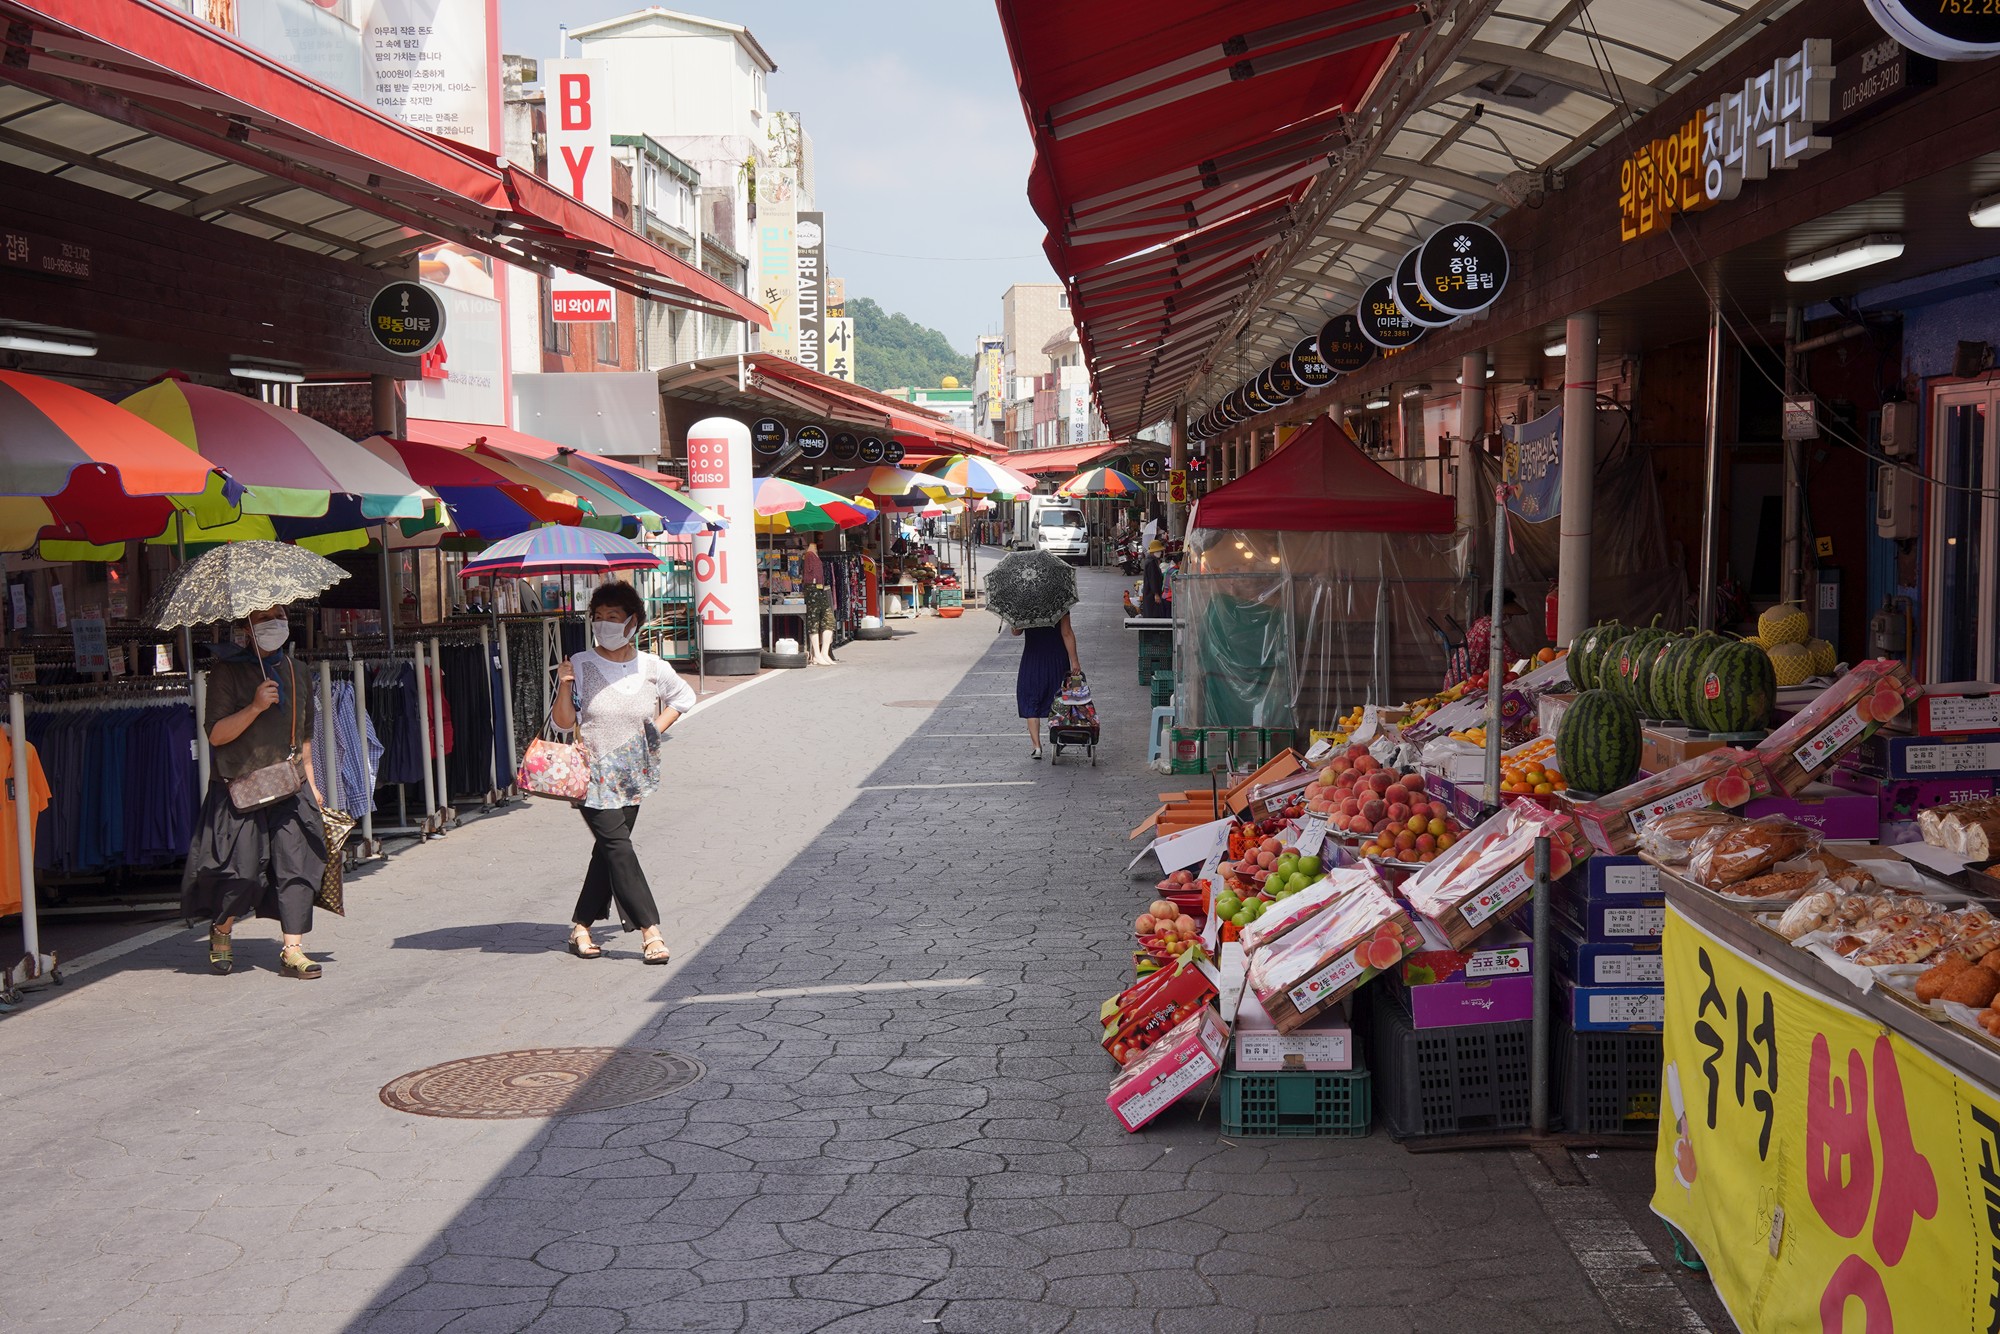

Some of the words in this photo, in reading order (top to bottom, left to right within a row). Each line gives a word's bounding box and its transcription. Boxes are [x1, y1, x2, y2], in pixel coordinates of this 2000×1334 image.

[374, 26, 398, 36] 아무리
[400, 26, 416, 36] 작은
[418, 26, 434, 36] 돈도
[376, 39, 384, 48] 그
[386, 39, 401, 49] 속에
[404, 39, 419, 49] 담긴
[376, 52, 390, 62] 땀의
[393, 52, 416, 62] 가치는
[419, 52, 441, 61] 큽니다
[376, 70, 412, 79] 1,000원이
[415, 70, 445, 79] 소중하게
[376, 84, 391, 93] 대접
[394, 84, 409, 93] 받는
[412, 83, 445, 92] 국민가게,
[376, 97, 407, 106] 다이소는
[410, 97, 432, 106] 작지만
[410, 113, 433, 122] 드리는
[436, 113, 458, 122] 만족은
[1702, 38, 1836, 200] 청과직판
[436, 126, 474, 135] 좋겠습니다
[1449, 257, 1479, 273] 중앙
[1435, 273, 1494, 292] 당구클럽
[797, 257, 818, 322] BEAUTY
[377, 315, 432, 333] 명동의류
[388, 338, 421, 346] 752.1742
[1330, 341, 1364, 353] 동아사
[691, 470, 724, 483] daiso
[1833, 716, 1858, 739] 복숭아
[1500, 874, 1525, 895] 복숭아
[1329, 961, 1356, 980] 복숭아
